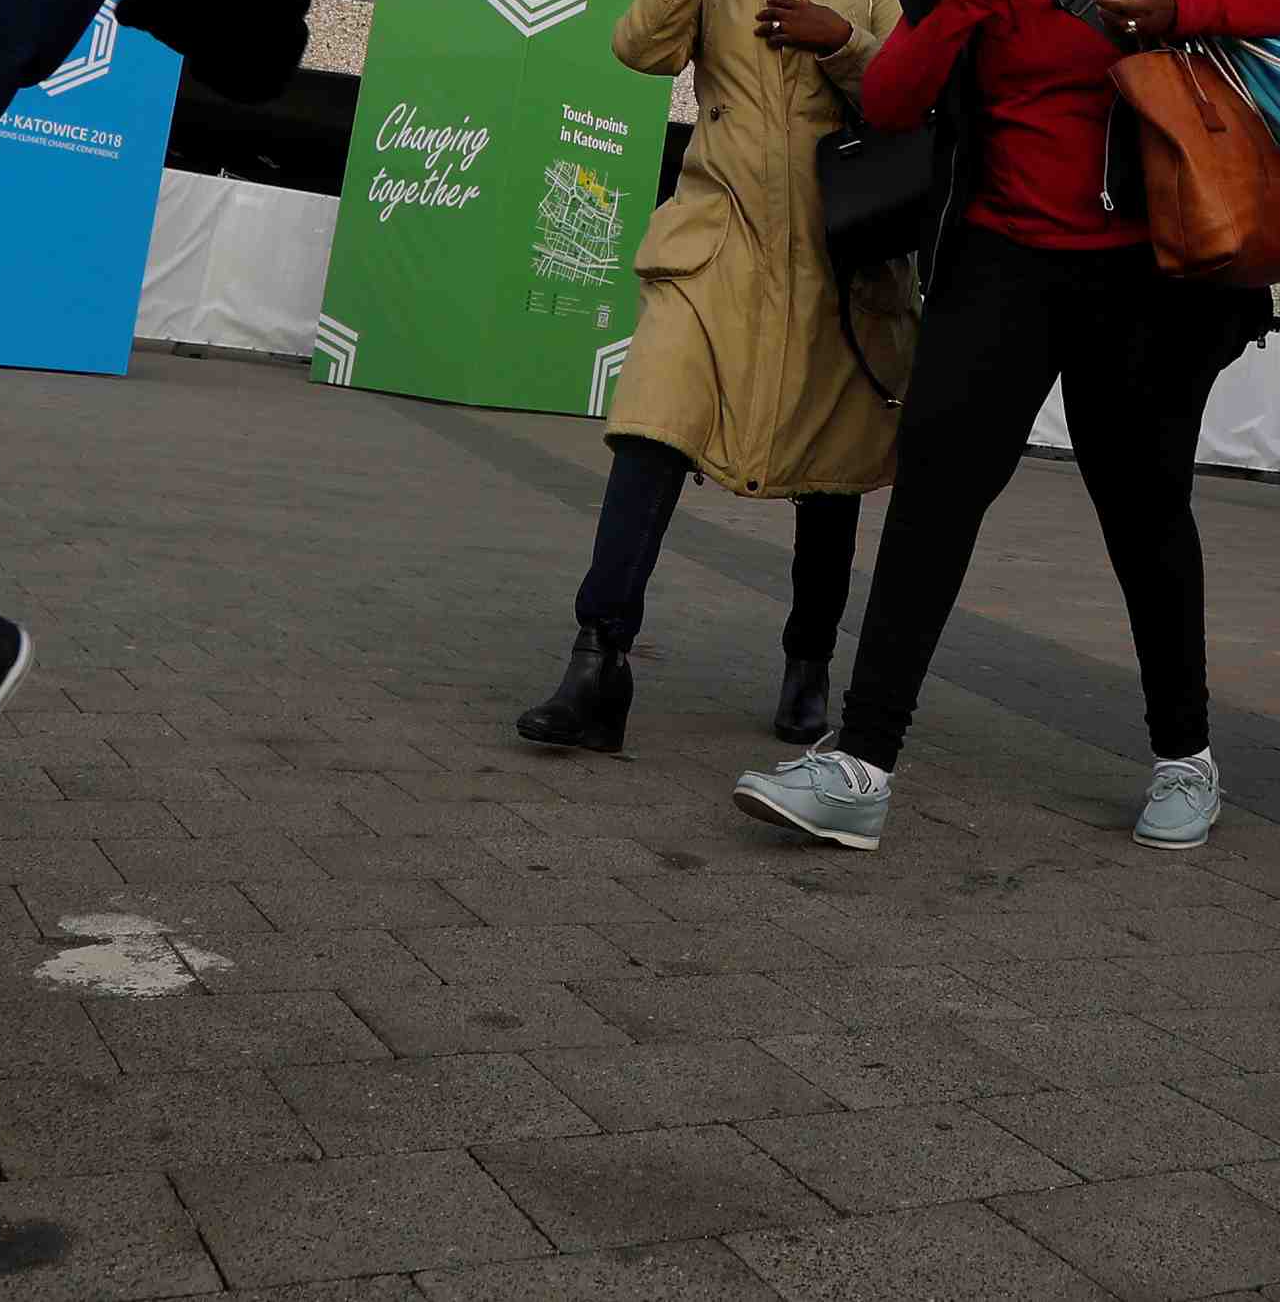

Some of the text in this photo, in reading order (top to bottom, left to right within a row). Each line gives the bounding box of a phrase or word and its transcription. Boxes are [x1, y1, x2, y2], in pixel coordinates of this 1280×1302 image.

[562, 104, 629, 136] Touch points
[90, 129, 123, 148] 2018
[376, 103, 490, 171] Changing
[560, 125, 623, 155] in Katowice
[368, 163, 481, 222] together
